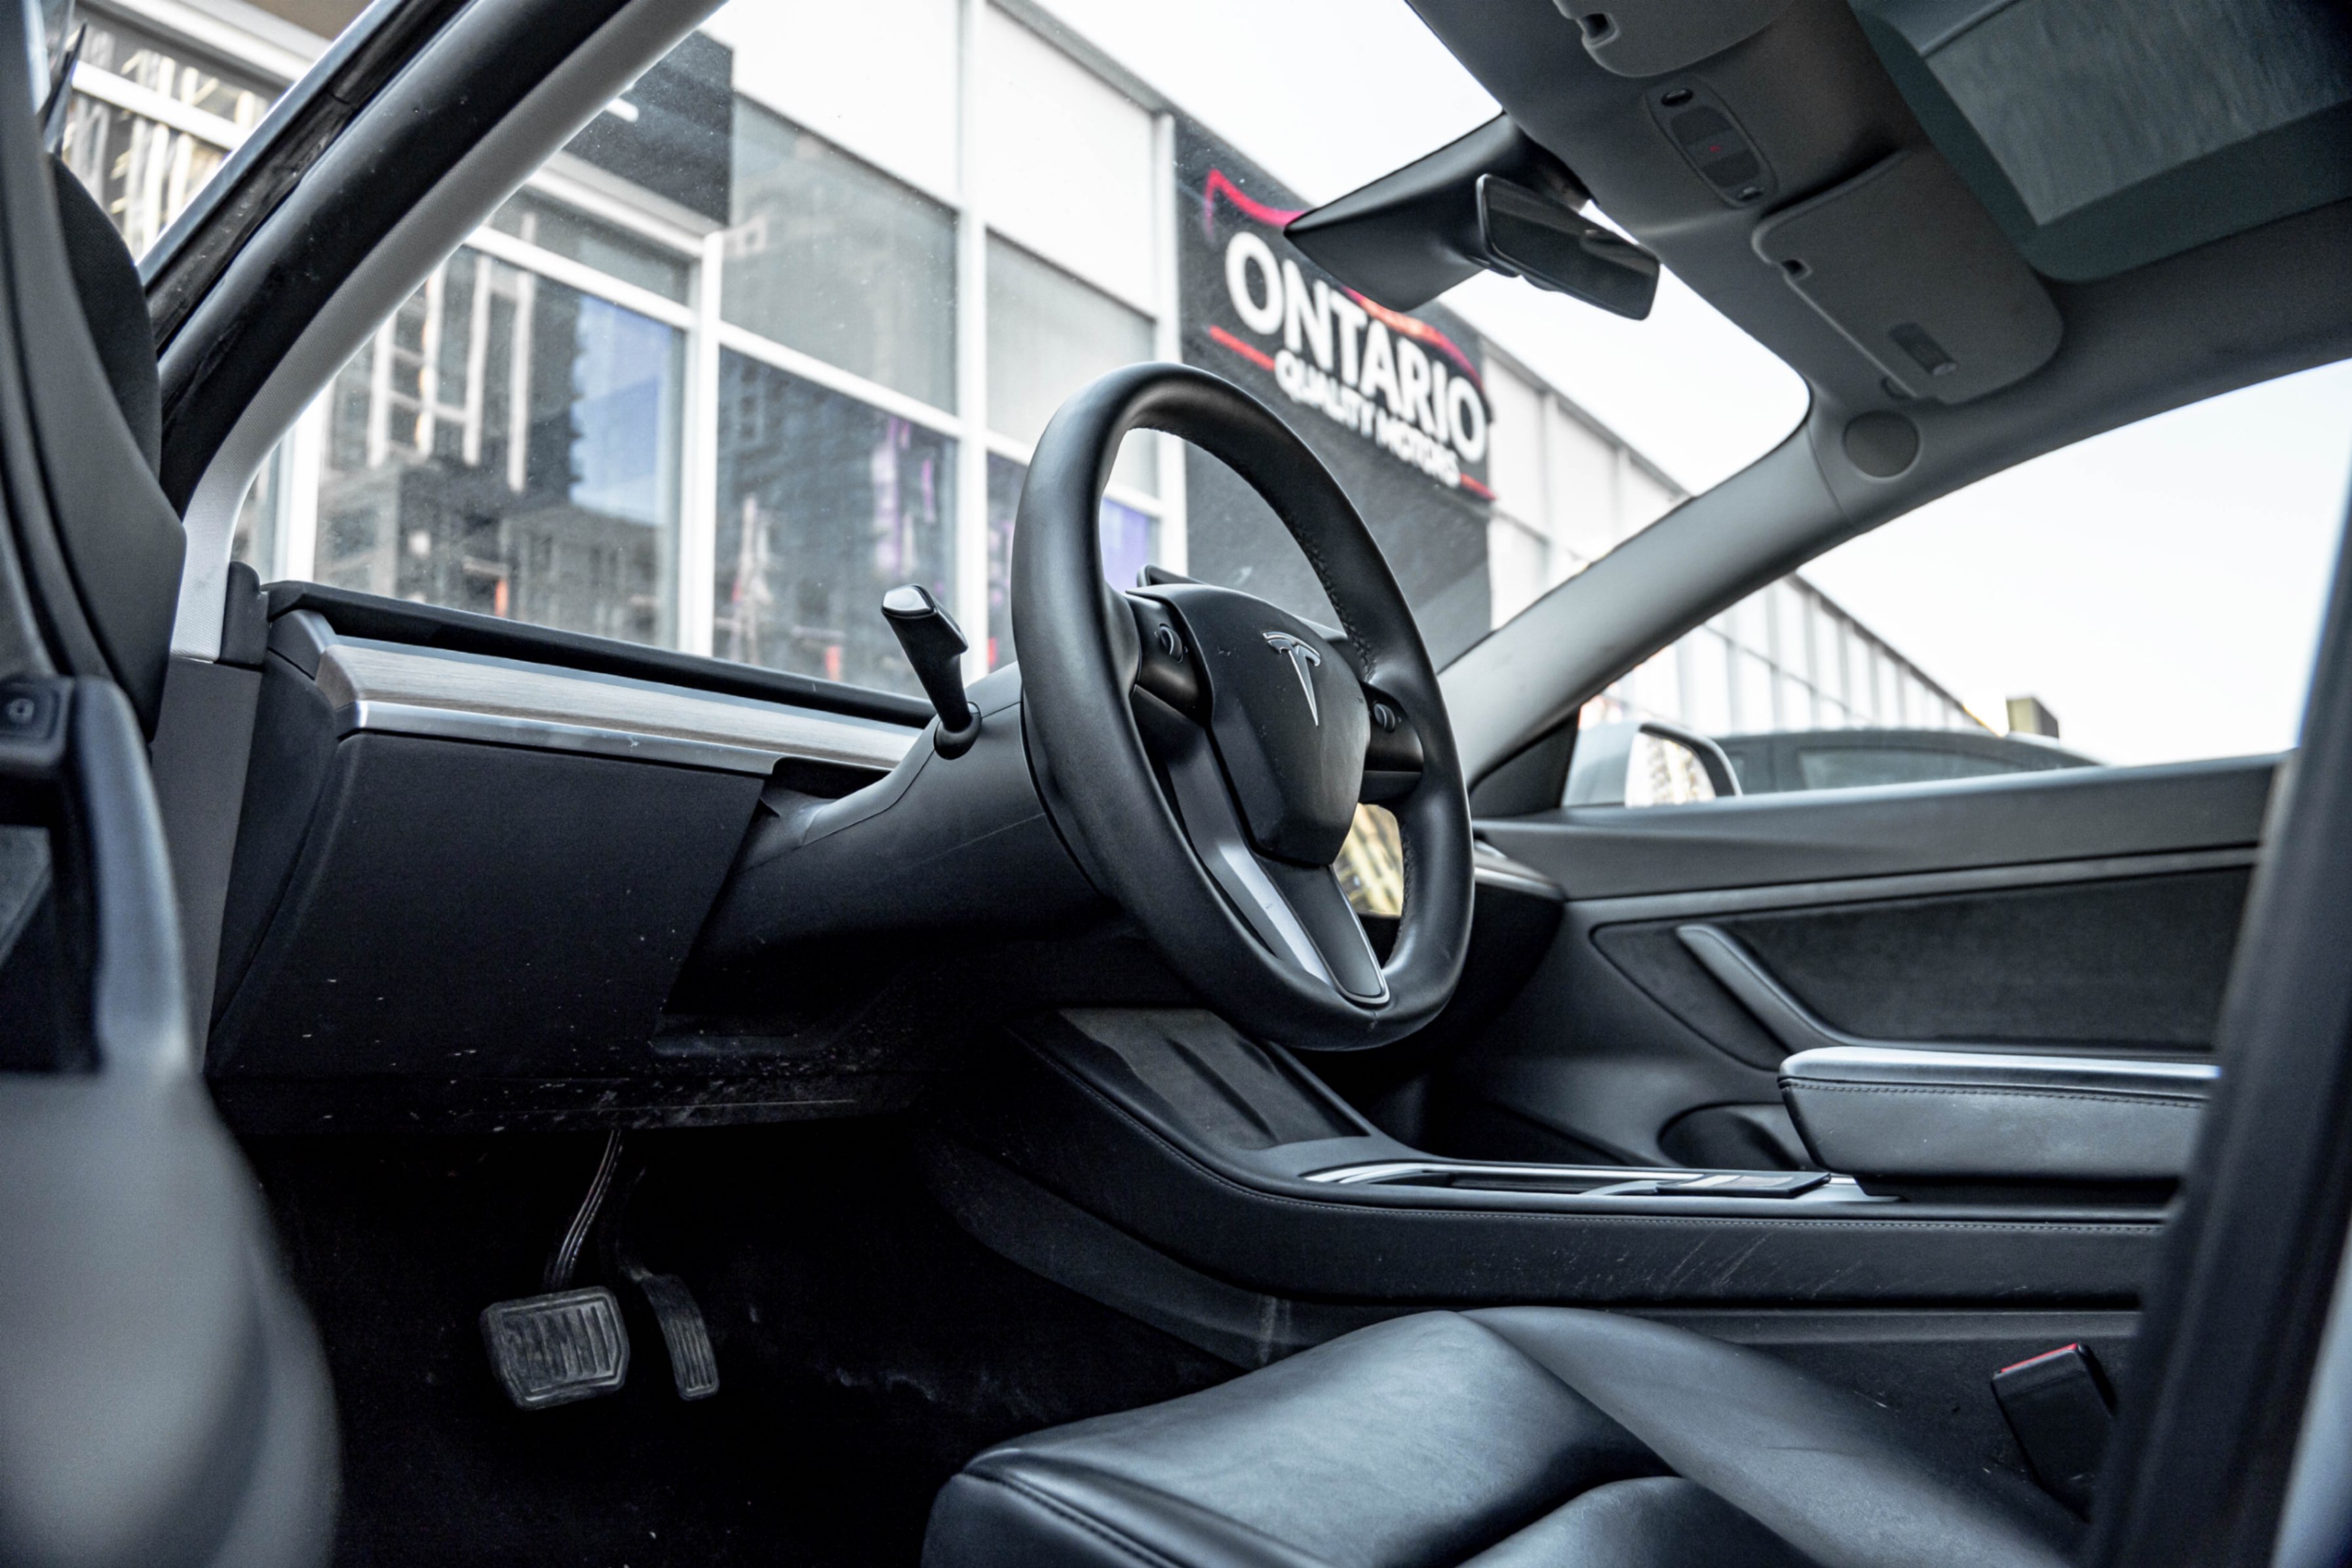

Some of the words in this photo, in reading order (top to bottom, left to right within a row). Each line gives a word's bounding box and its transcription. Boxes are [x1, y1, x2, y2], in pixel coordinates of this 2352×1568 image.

[1225, 231, 1486, 463] ONTARIO
[1275, 349, 1376, 437] QUALITY
[1376, 408, 1461, 488] MOTORS
